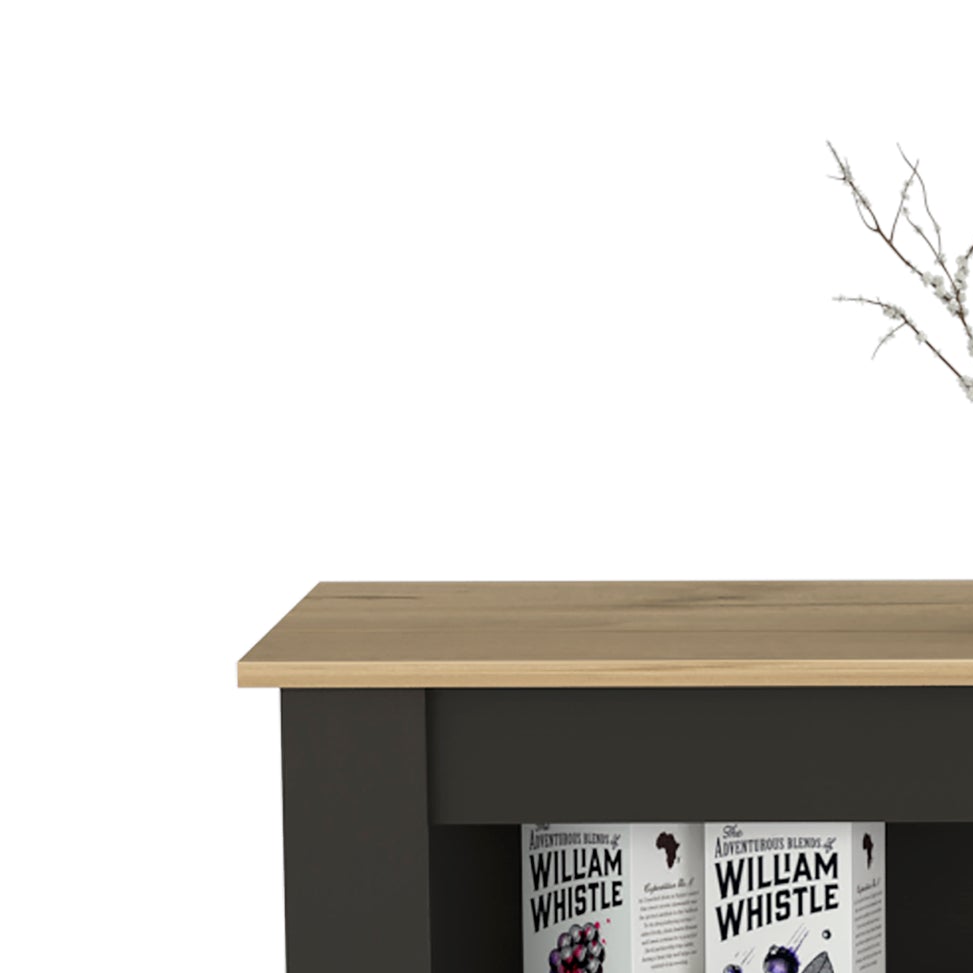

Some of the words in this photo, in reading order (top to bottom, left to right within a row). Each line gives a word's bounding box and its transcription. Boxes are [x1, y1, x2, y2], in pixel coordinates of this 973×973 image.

[722, 824, 743, 839] The
[787, 837, 822, 850] BLENDS
[529, 848, 622, 891] WILLIAM
[715, 852, 838, 899] WILLIAM
[530, 880, 623, 932] WHISTLE
[715, 884, 839, 941] WHISTLE
